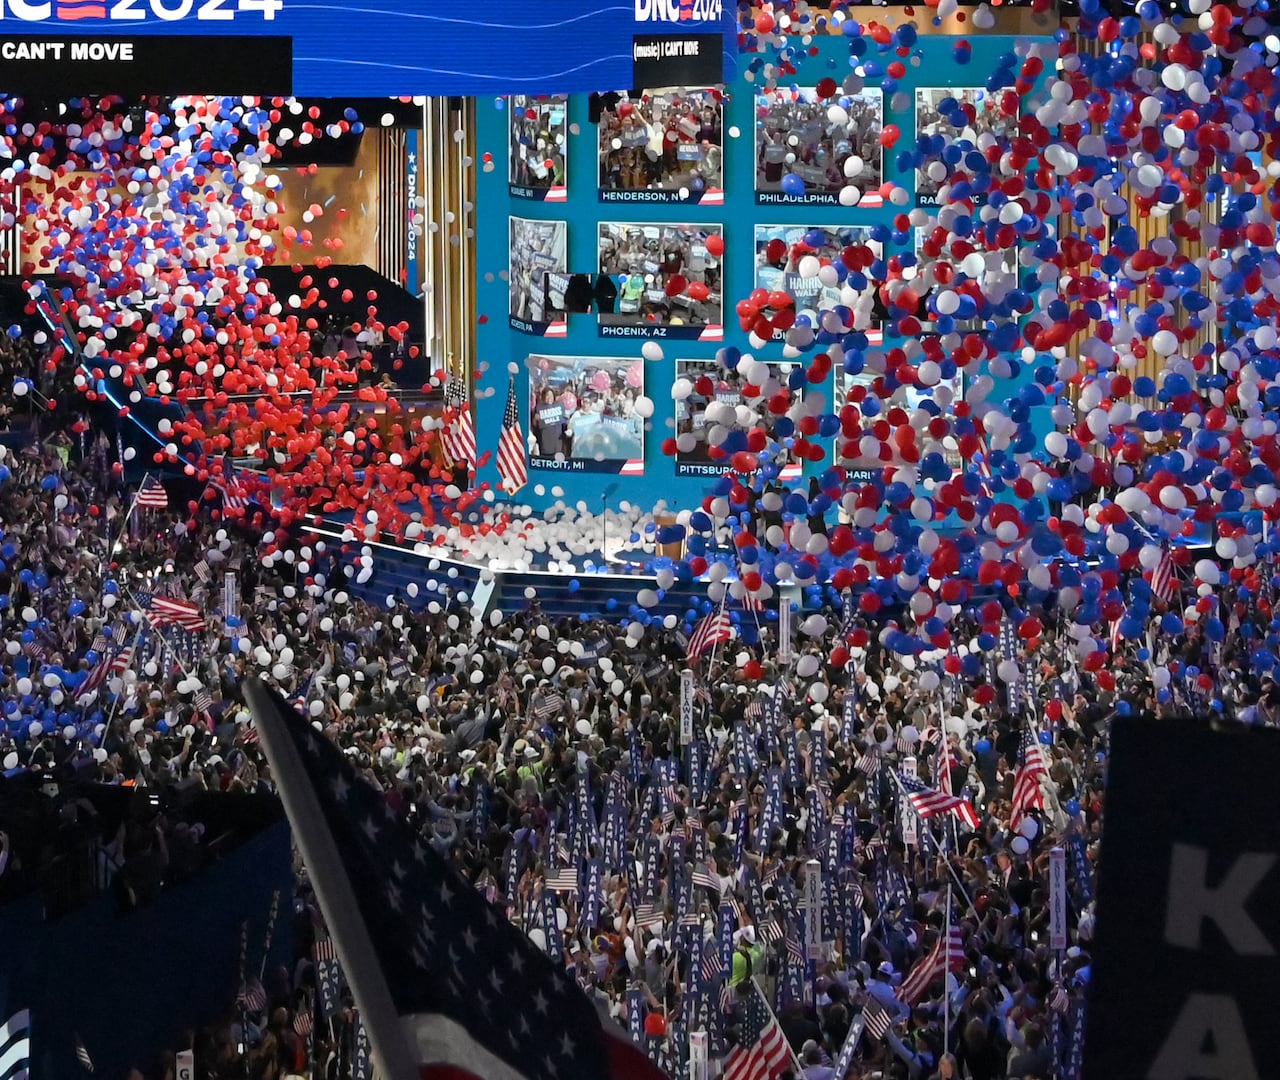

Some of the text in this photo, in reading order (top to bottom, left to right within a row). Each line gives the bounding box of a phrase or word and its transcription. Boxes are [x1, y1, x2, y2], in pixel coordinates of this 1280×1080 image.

[3, 42, 64, 61] CAN'T
[70, 42, 134, 60] MOVE
[634, 42, 660, 62] (music)
[665, 41, 683, 56] CAN'T
[684, 41, 699, 55] MOVE
[602, 192, 669, 202] HENDERSON,
[759, 194, 837, 205] PHILADELPHIA,
[602, 327, 667, 337] PHOENIX, AZ
[539, 405, 562, 420] HARRIS
[530, 458, 584, 470] DETROIT, MI
[764, 703, 773, 747] KAMALA
[844, 700, 853, 743] KAMALA
[690, 745, 699, 795] KAMALA
[735, 725, 745, 773] KAMALA
[787, 736, 797, 783] KAMALA
[475, 782, 483, 835] KAMALA
[638, 786, 655, 835] KAMALA
[758, 795, 773, 848] KAMALA
[507, 847, 518, 902] KAMALA
[587, 864, 597, 921] KAMALA
[647, 846, 657, 897] KAMALA
[545, 897, 557, 958] KAMALA
[722, 911, 731, 971] KAMALA
[690, 931, 700, 993] KAMALA
[1073, 1008, 1085, 1077] KAMALA
